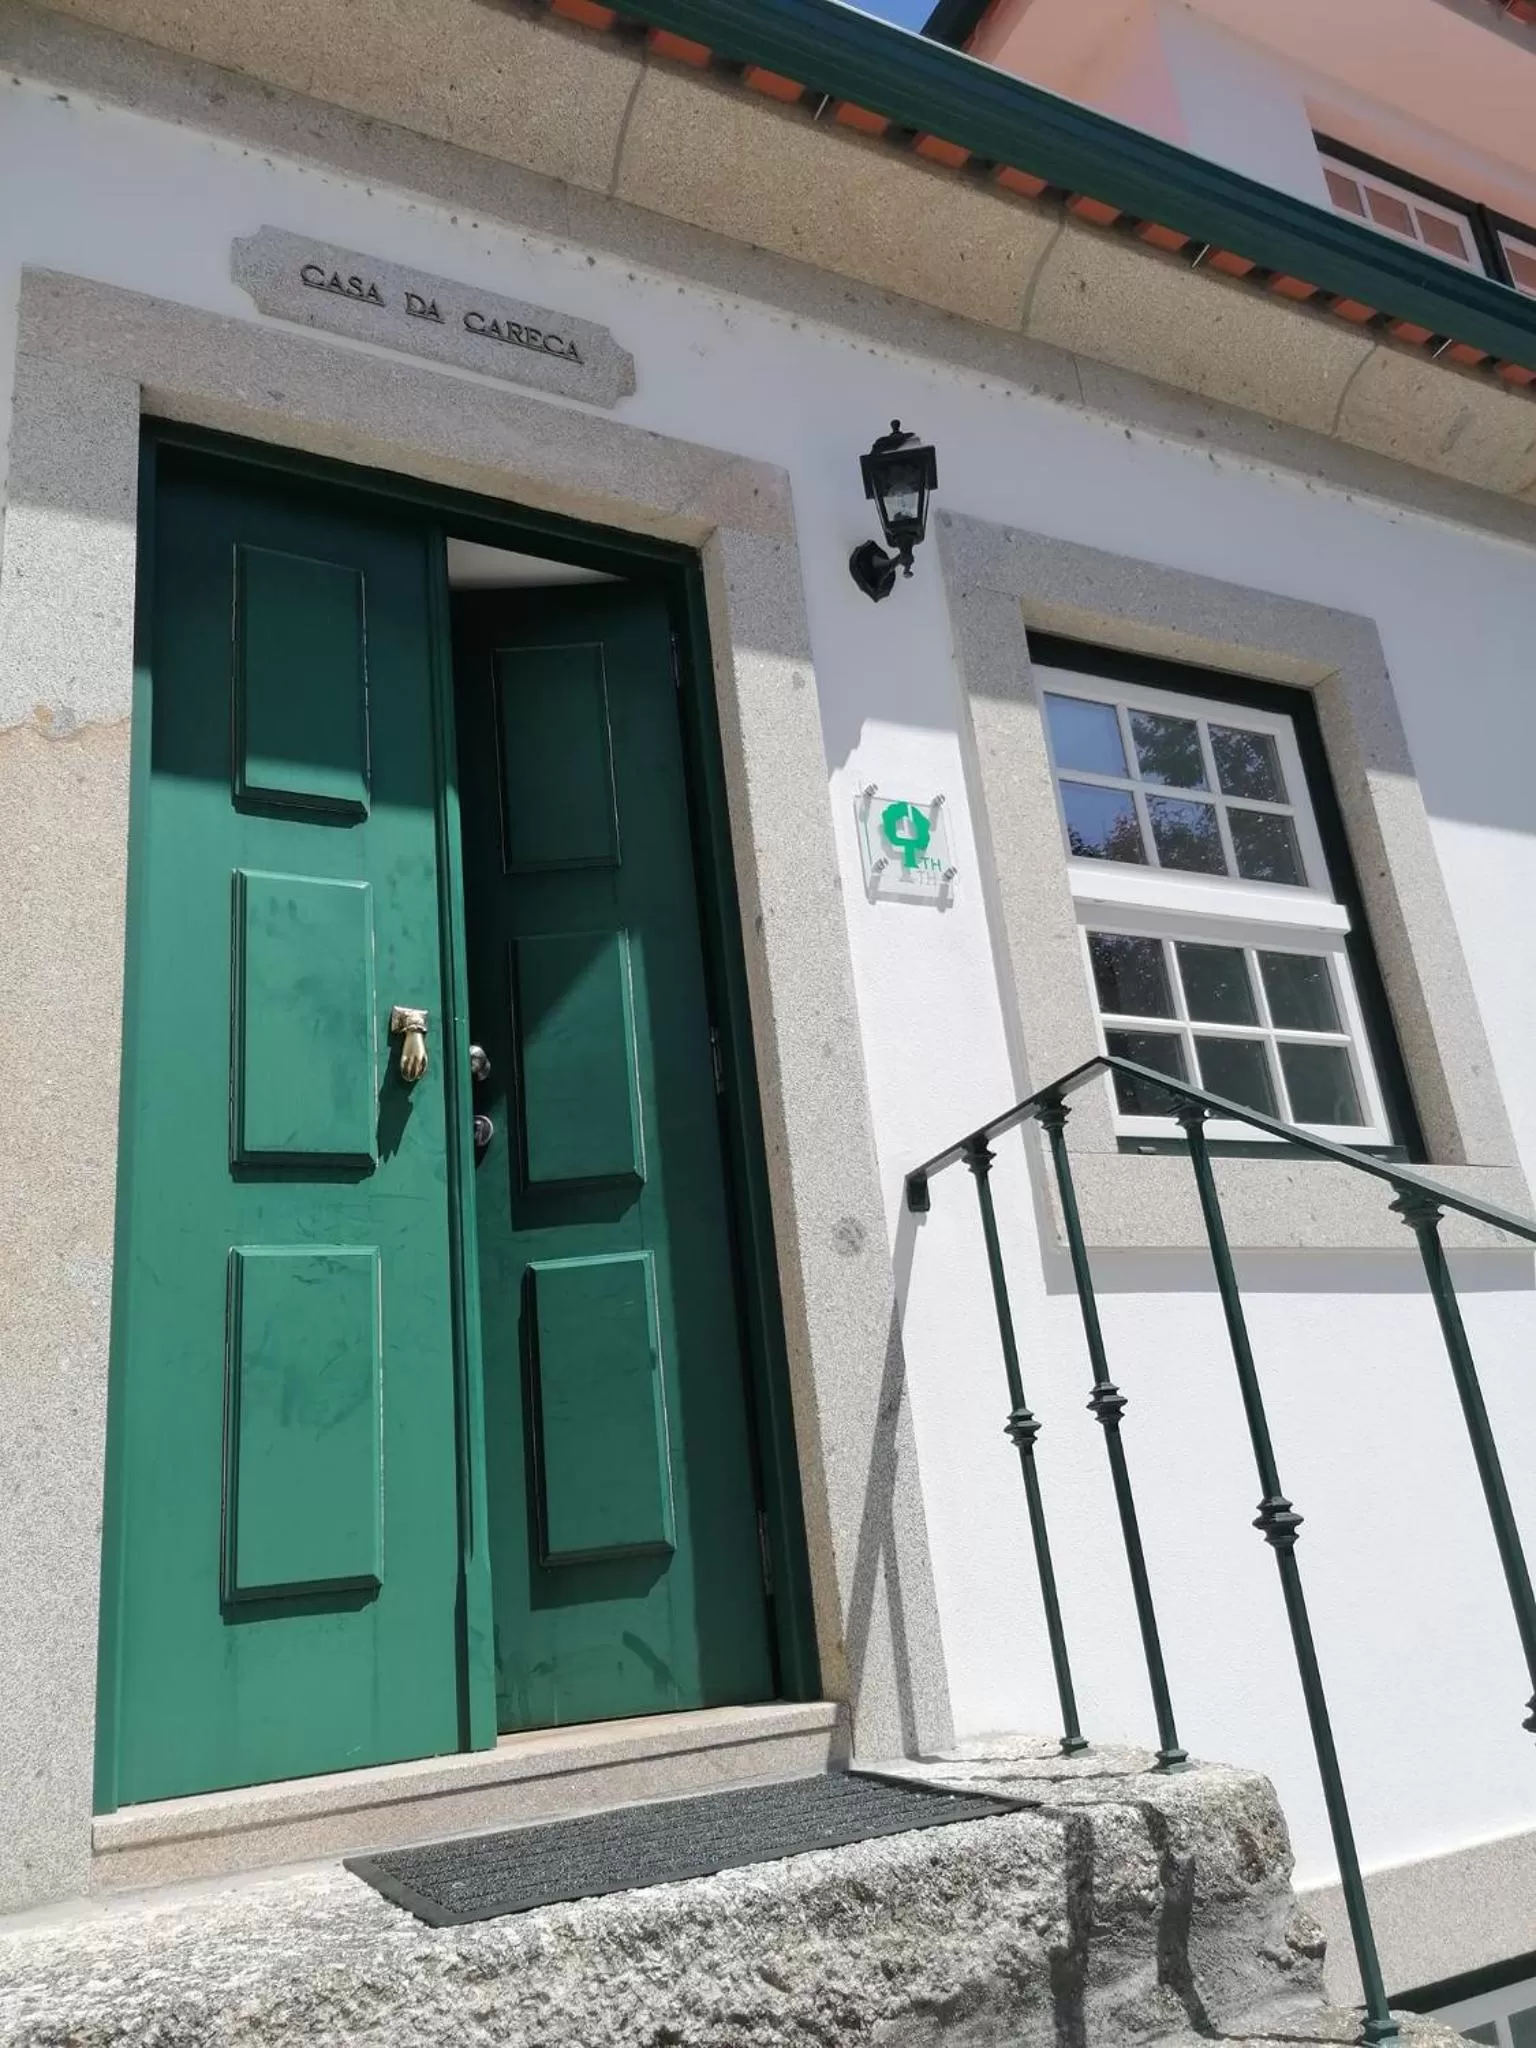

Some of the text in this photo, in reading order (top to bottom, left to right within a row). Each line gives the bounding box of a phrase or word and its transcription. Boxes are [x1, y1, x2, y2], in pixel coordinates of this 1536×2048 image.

[300, 263, 584, 363] CASA DA CARECA
[919, 856, 942, 872] TH
